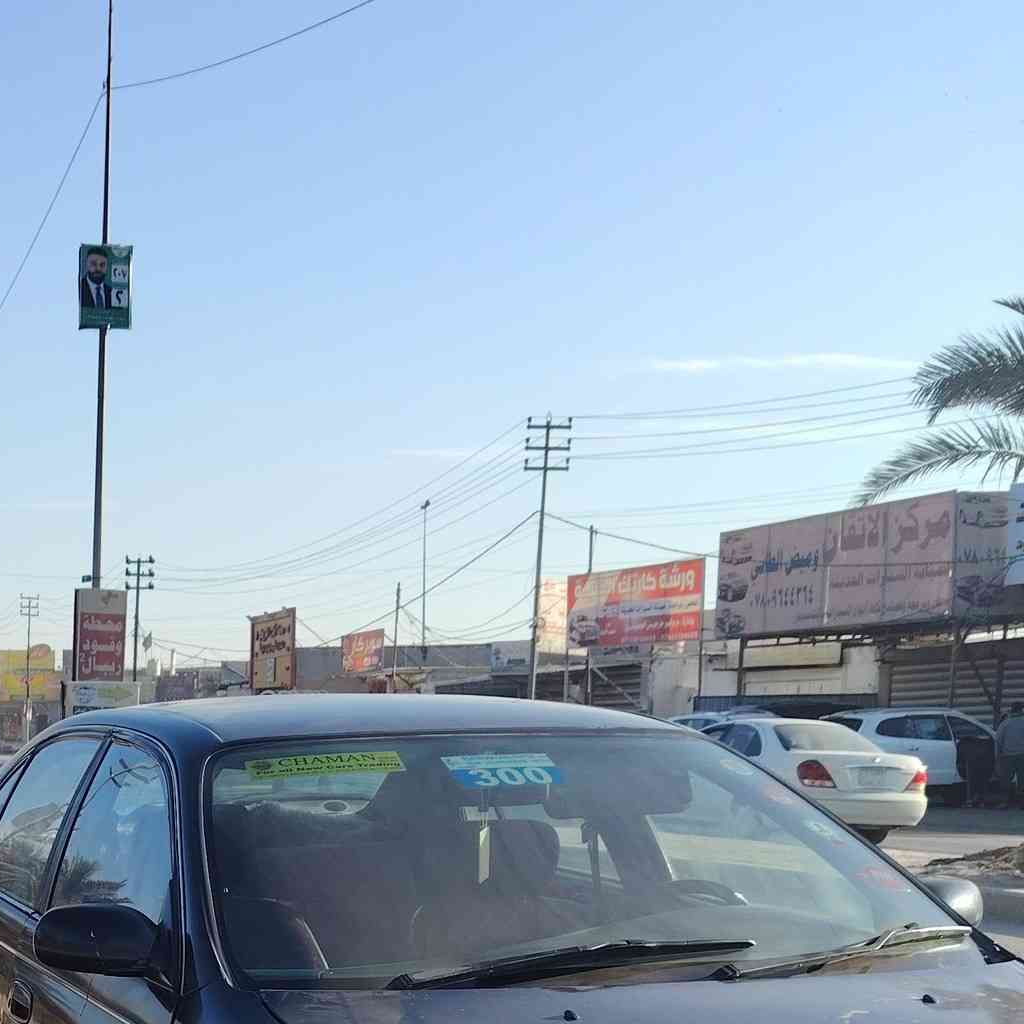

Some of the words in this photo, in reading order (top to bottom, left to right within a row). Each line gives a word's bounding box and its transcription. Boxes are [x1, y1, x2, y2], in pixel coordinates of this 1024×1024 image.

[890, 499, 951, 553] مركز
[83, 614, 121, 632] محطة
[278, 752, 376, 767] CHAMAN
[468, 767, 552, 785] 300
